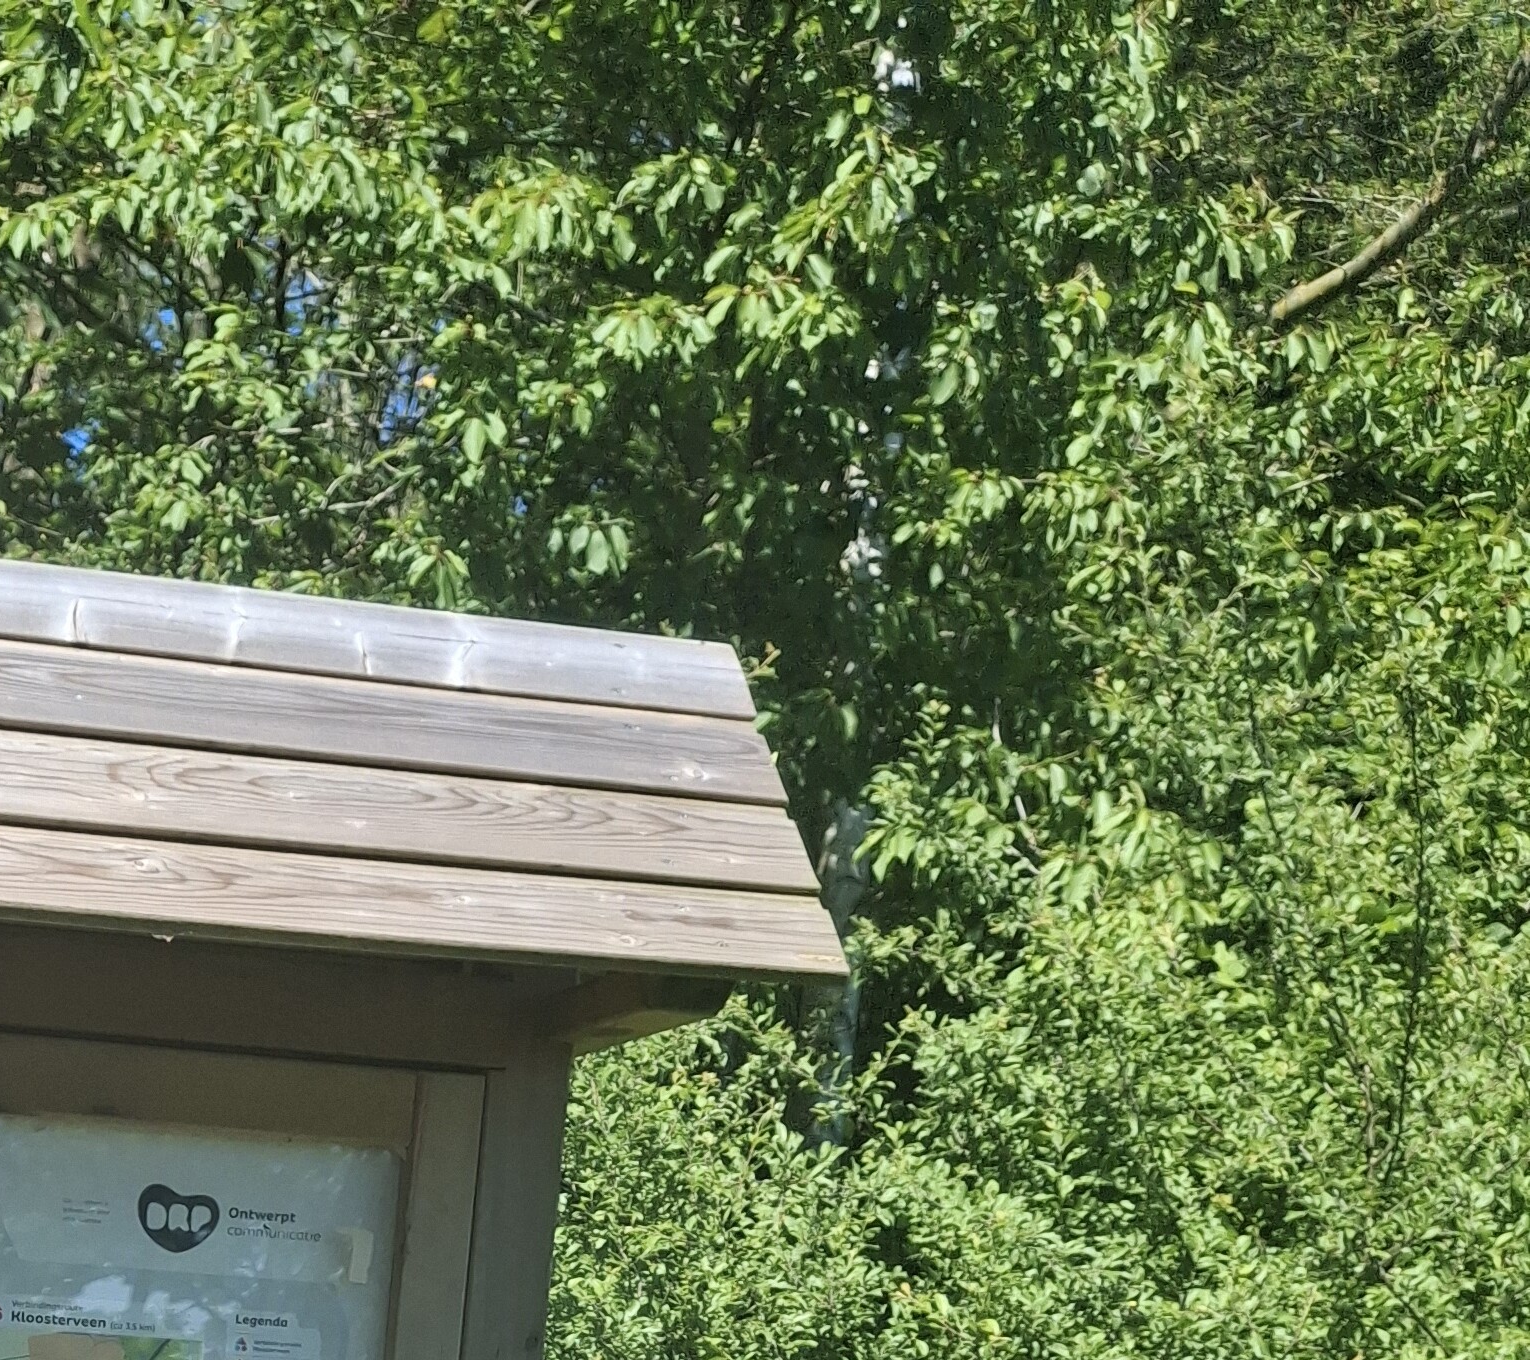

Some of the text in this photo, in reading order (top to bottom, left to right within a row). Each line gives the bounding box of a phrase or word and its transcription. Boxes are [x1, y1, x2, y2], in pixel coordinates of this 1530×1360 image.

[228, 1207, 297, 1225] Ontwerpt
[10, 1311, 107, 1329] Kloosterveen
[234, 1314, 289, 1328] Legenda
